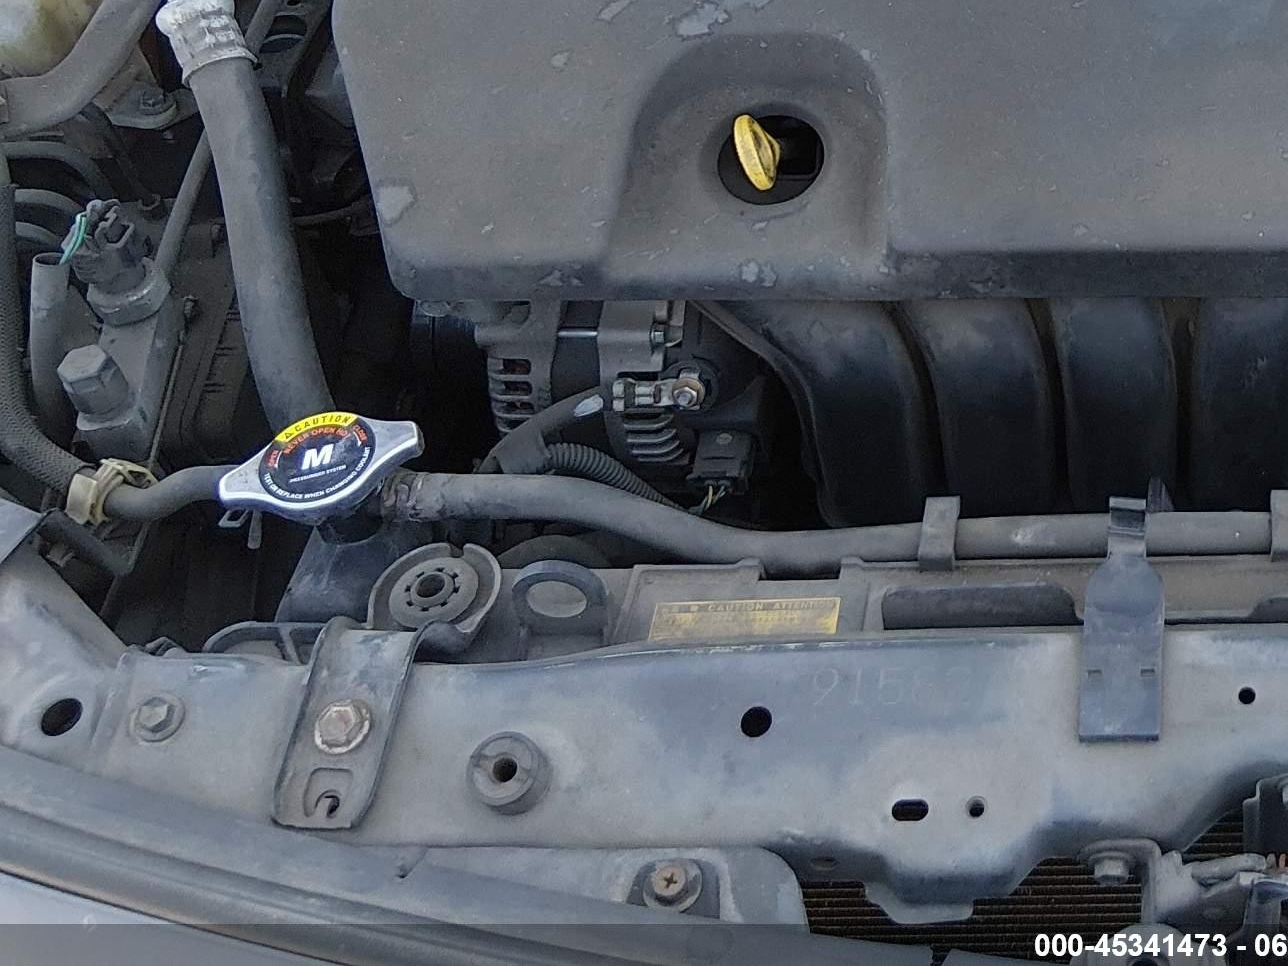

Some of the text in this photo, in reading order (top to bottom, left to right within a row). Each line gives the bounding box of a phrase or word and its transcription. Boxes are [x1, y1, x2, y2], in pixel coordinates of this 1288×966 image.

[293, 414, 352, 432] CAUTION
[311, 425, 336, 437] OPEN
[301, 443, 334, 470] M
[277, 489, 303, 500] REPLACE
[304, 490, 325, 500] WHEN
[325, 469, 357, 494] CHANGING
[707, 601, 764, 612] CAUTION
